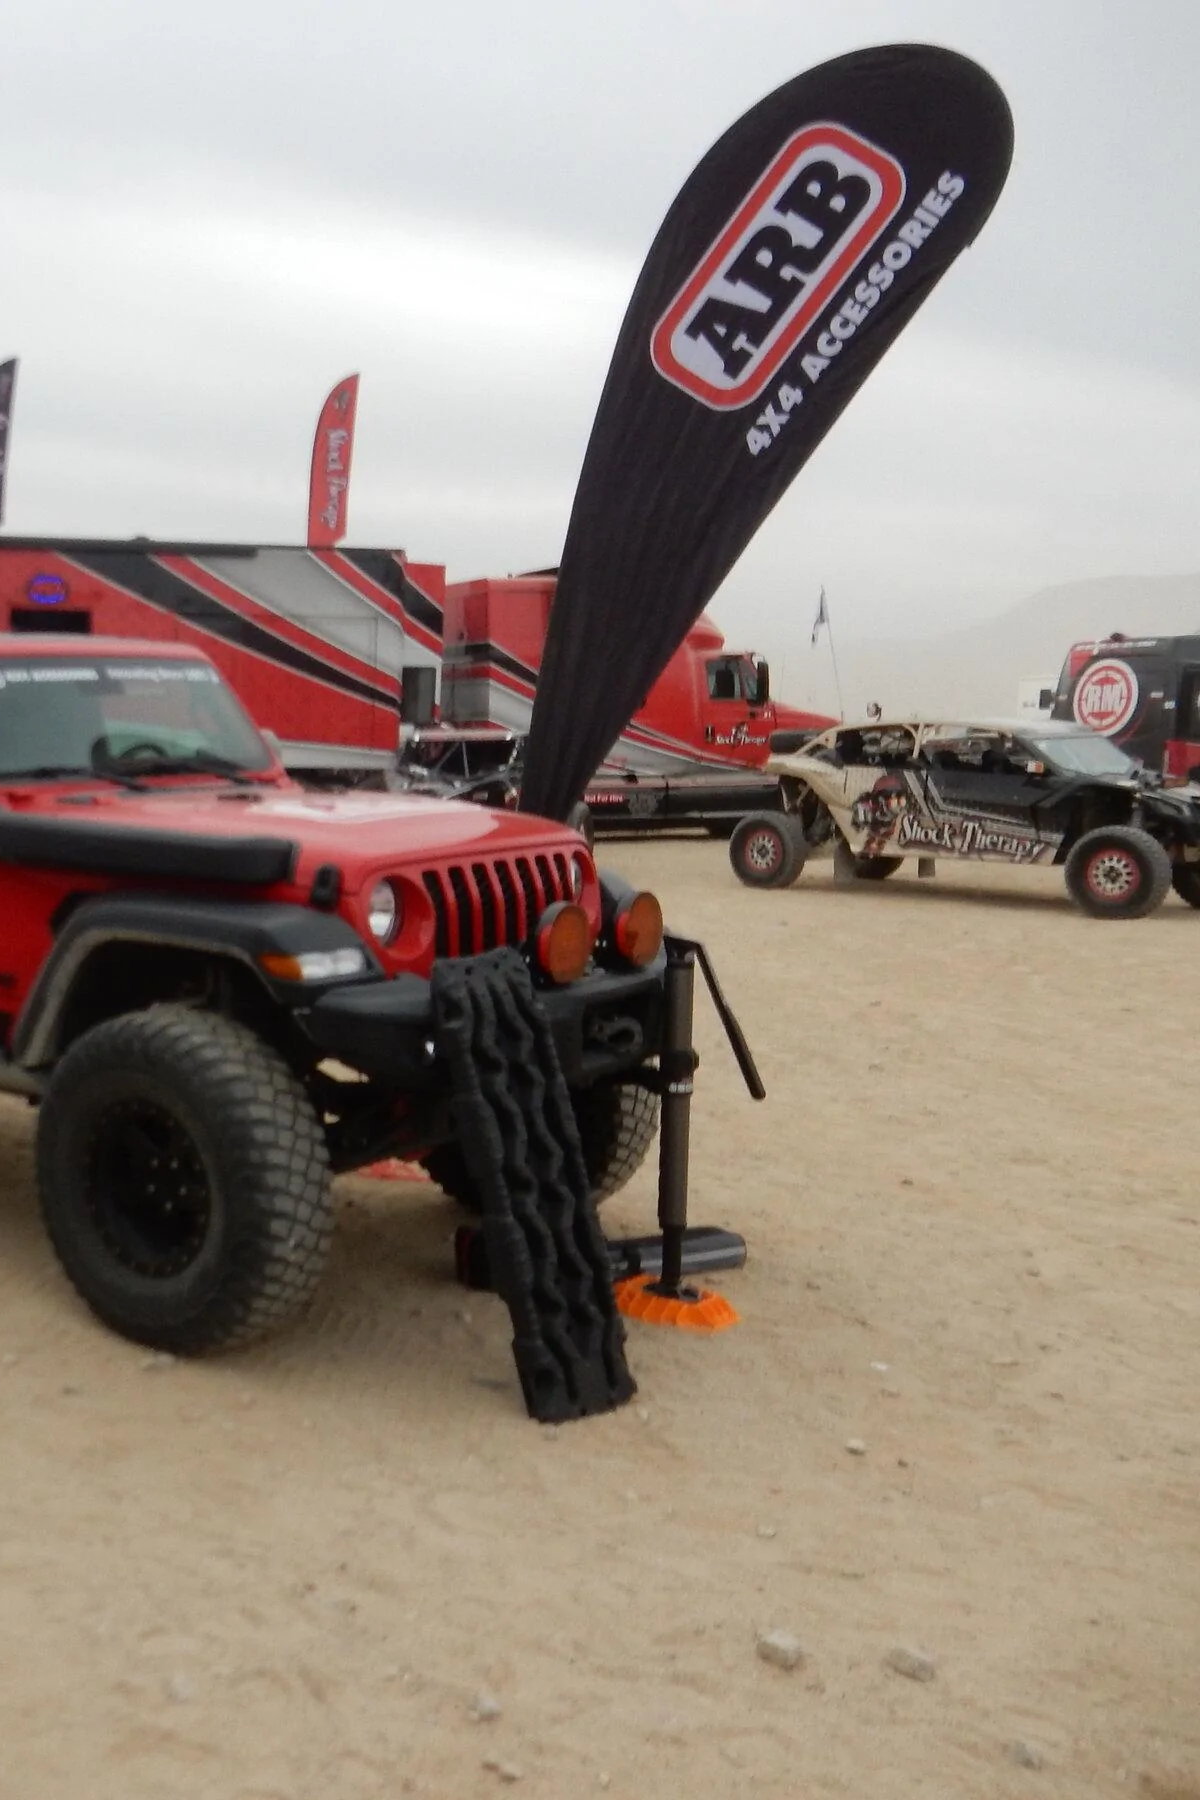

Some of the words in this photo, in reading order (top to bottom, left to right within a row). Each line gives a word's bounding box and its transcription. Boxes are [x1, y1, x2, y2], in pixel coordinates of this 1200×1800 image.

[684, 160, 871, 380] ARB
[800, 170, 966, 384] ACCESSORIES
[900, 814, 955, 849] Shock
[959, 820, 1046, 863] Therapy
